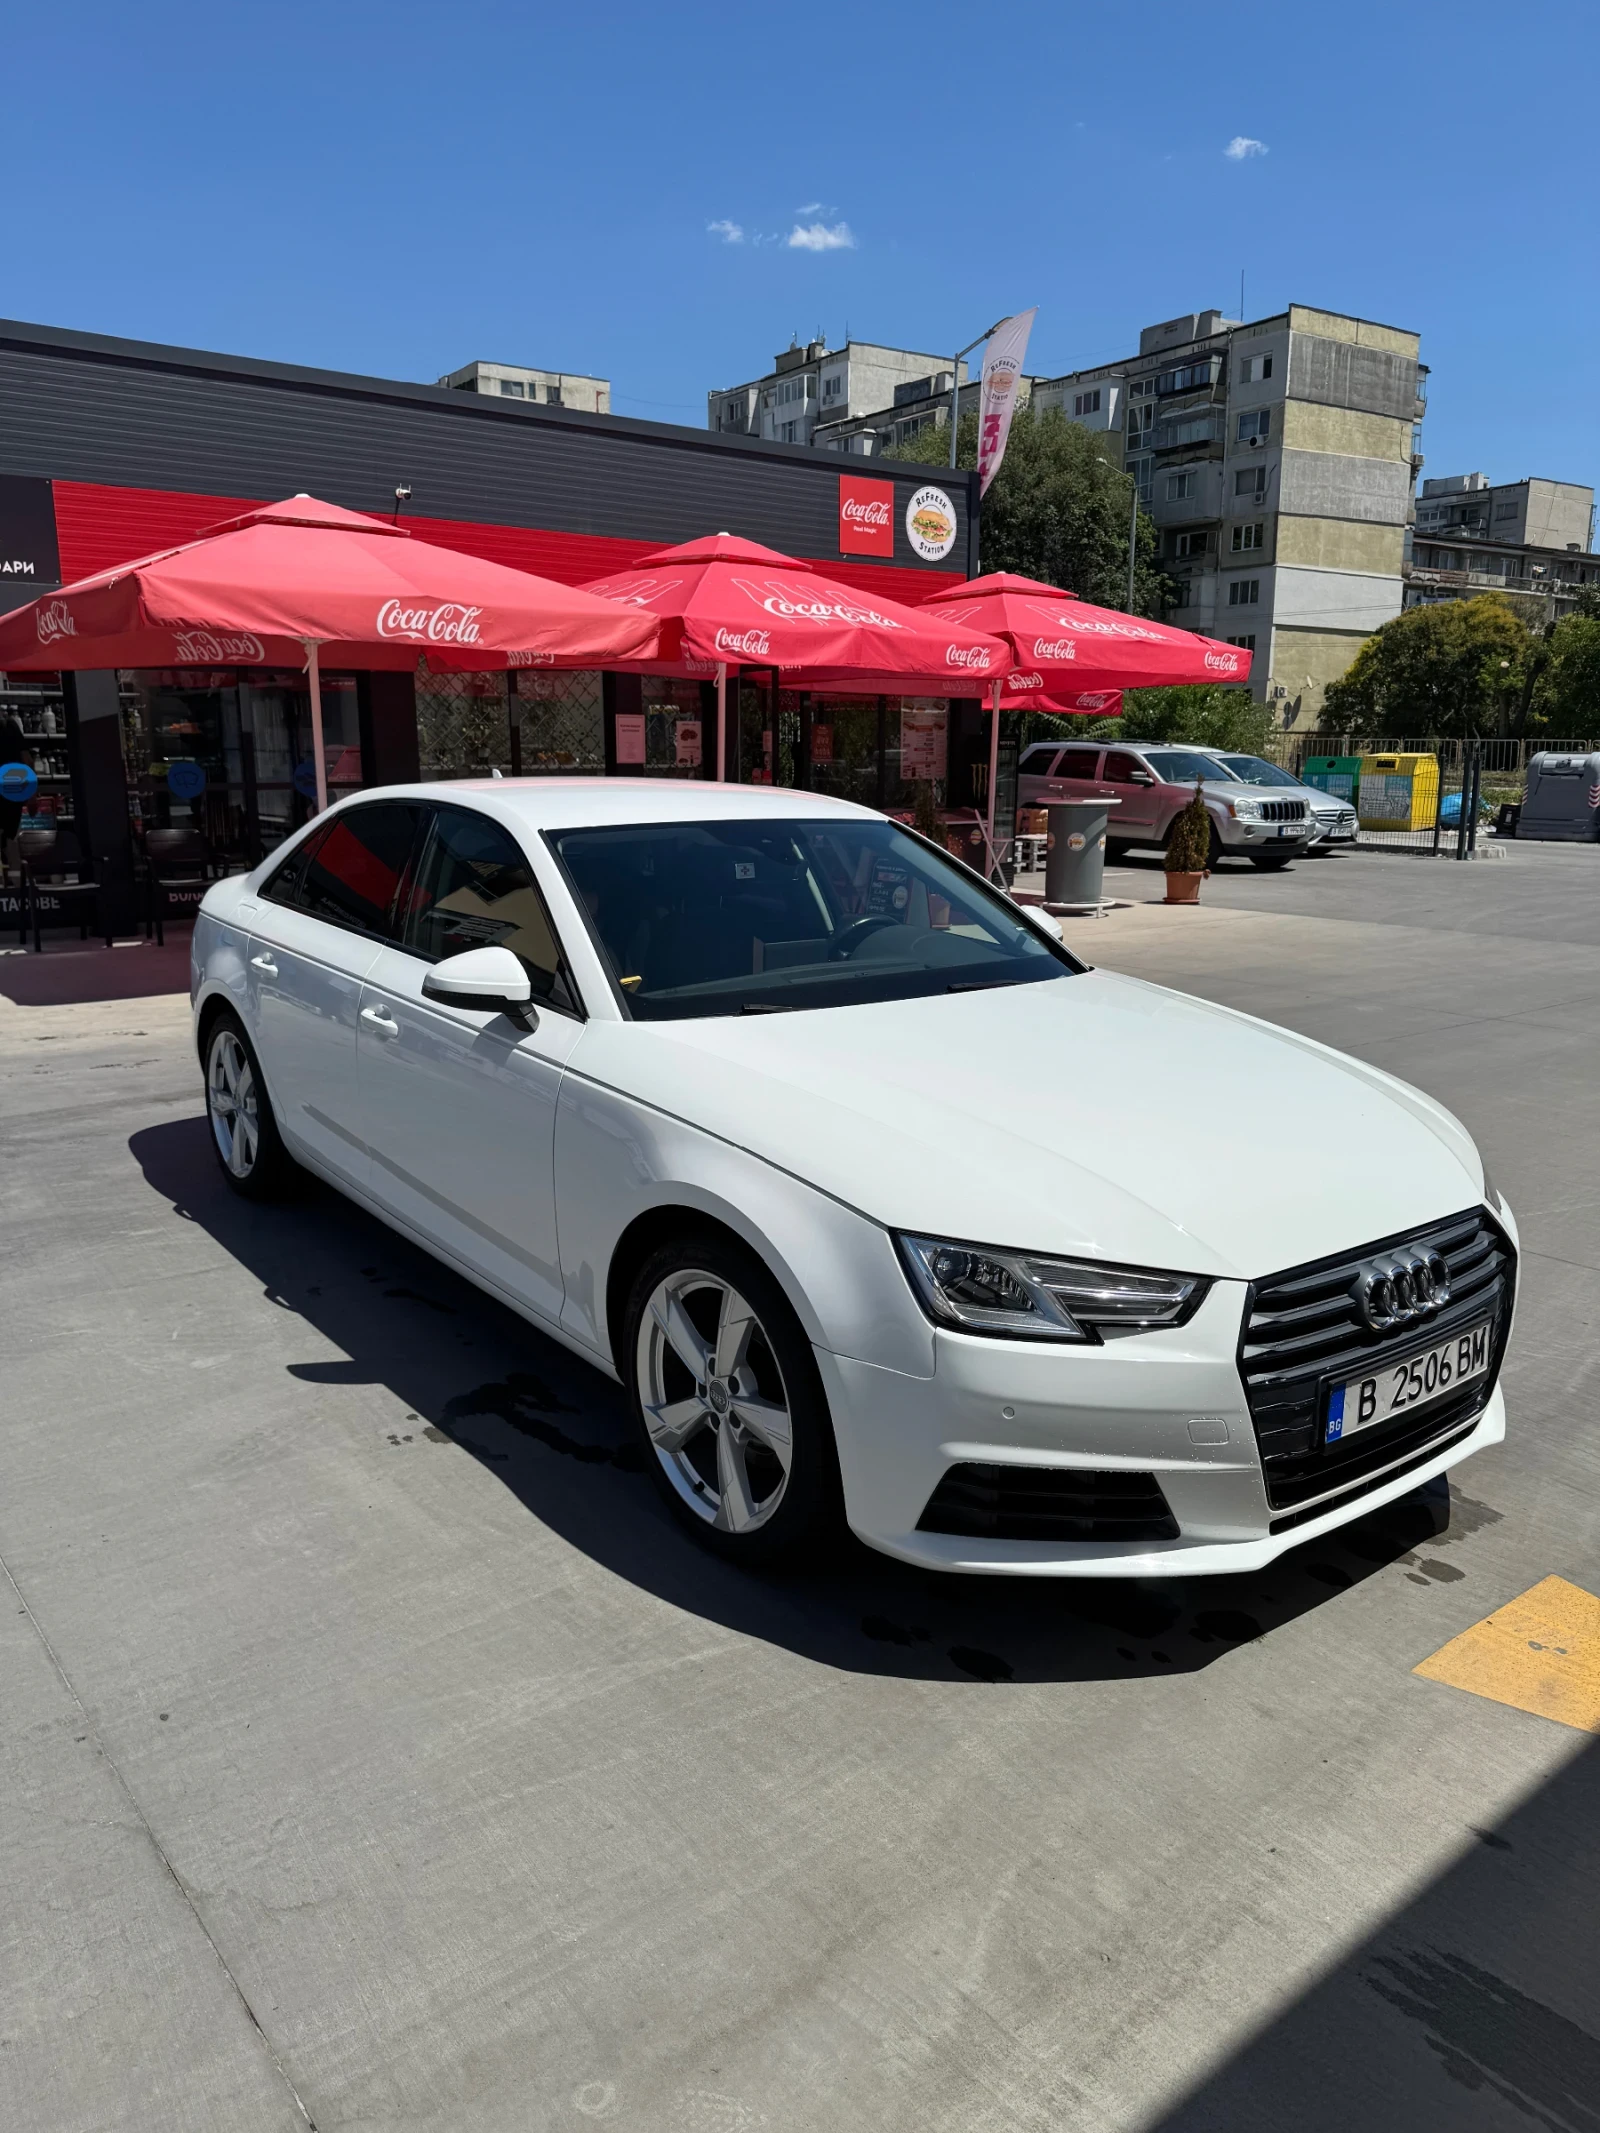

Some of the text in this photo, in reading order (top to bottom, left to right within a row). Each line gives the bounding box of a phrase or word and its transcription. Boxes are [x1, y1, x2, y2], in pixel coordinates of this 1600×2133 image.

[842, 498, 891, 525] Coca-Cola
[853, 525, 877, 534] Real Magic
[919, 541, 945, 555] STATION
[0, 559, 35, 575] АРИ
[36, 600, 79, 645] Coca-Cla
[376, 599, 484, 644] Coca-Cola
[763, 597, 903, 629] Coca-Cola
[715, 627, 771, 655] Coca-Cola
[1059, 617, 1168, 641] Coca-Cola
[946, 644, 990, 668] Coca-Cola
[1033, 637, 1076, 660] Coca-Cola
[1204, 650, 1238, 671] Coca-Cola
[1076, 692, 1108, 708] Coca-Cola
[1357, 1326, 1487, 1425] B 2506 BM
[1328, 1418, 1342, 1435] BG
